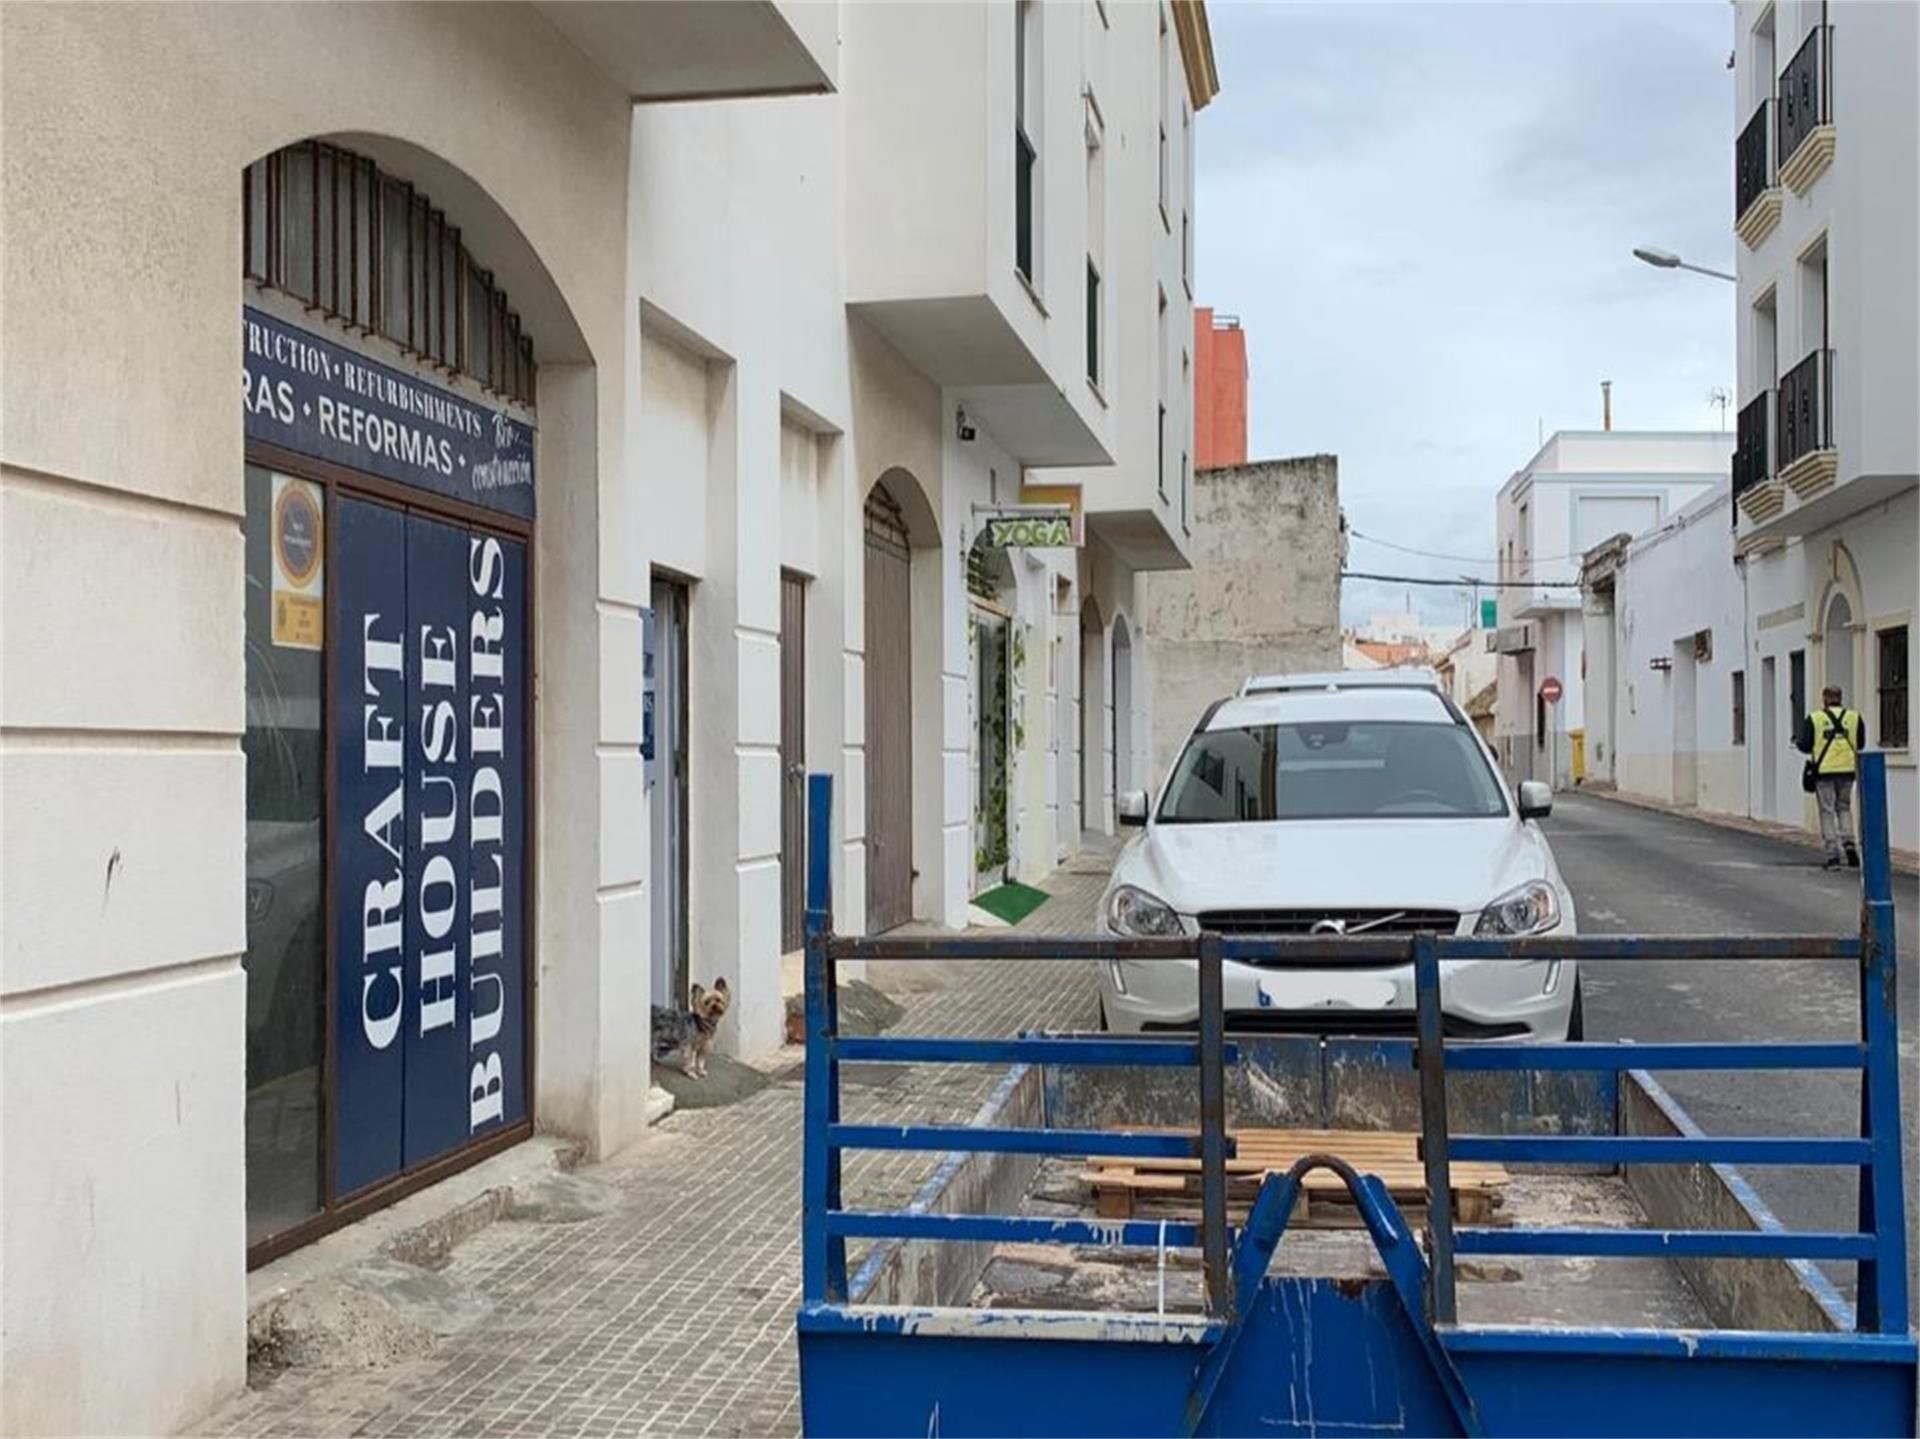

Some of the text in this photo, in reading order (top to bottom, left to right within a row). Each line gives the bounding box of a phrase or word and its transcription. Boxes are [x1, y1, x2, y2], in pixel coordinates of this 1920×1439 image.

[318, 395, 453, 476] REFORMAS
[344, 361, 483, 439] REFURBISHMENTS
[994, 520, 1068, 545] YOGA
[362, 613, 405, 1050] CRAFT
[419, 624, 457, 1039] HOUSE
[469, 537, 505, 1135] BUILDERS
